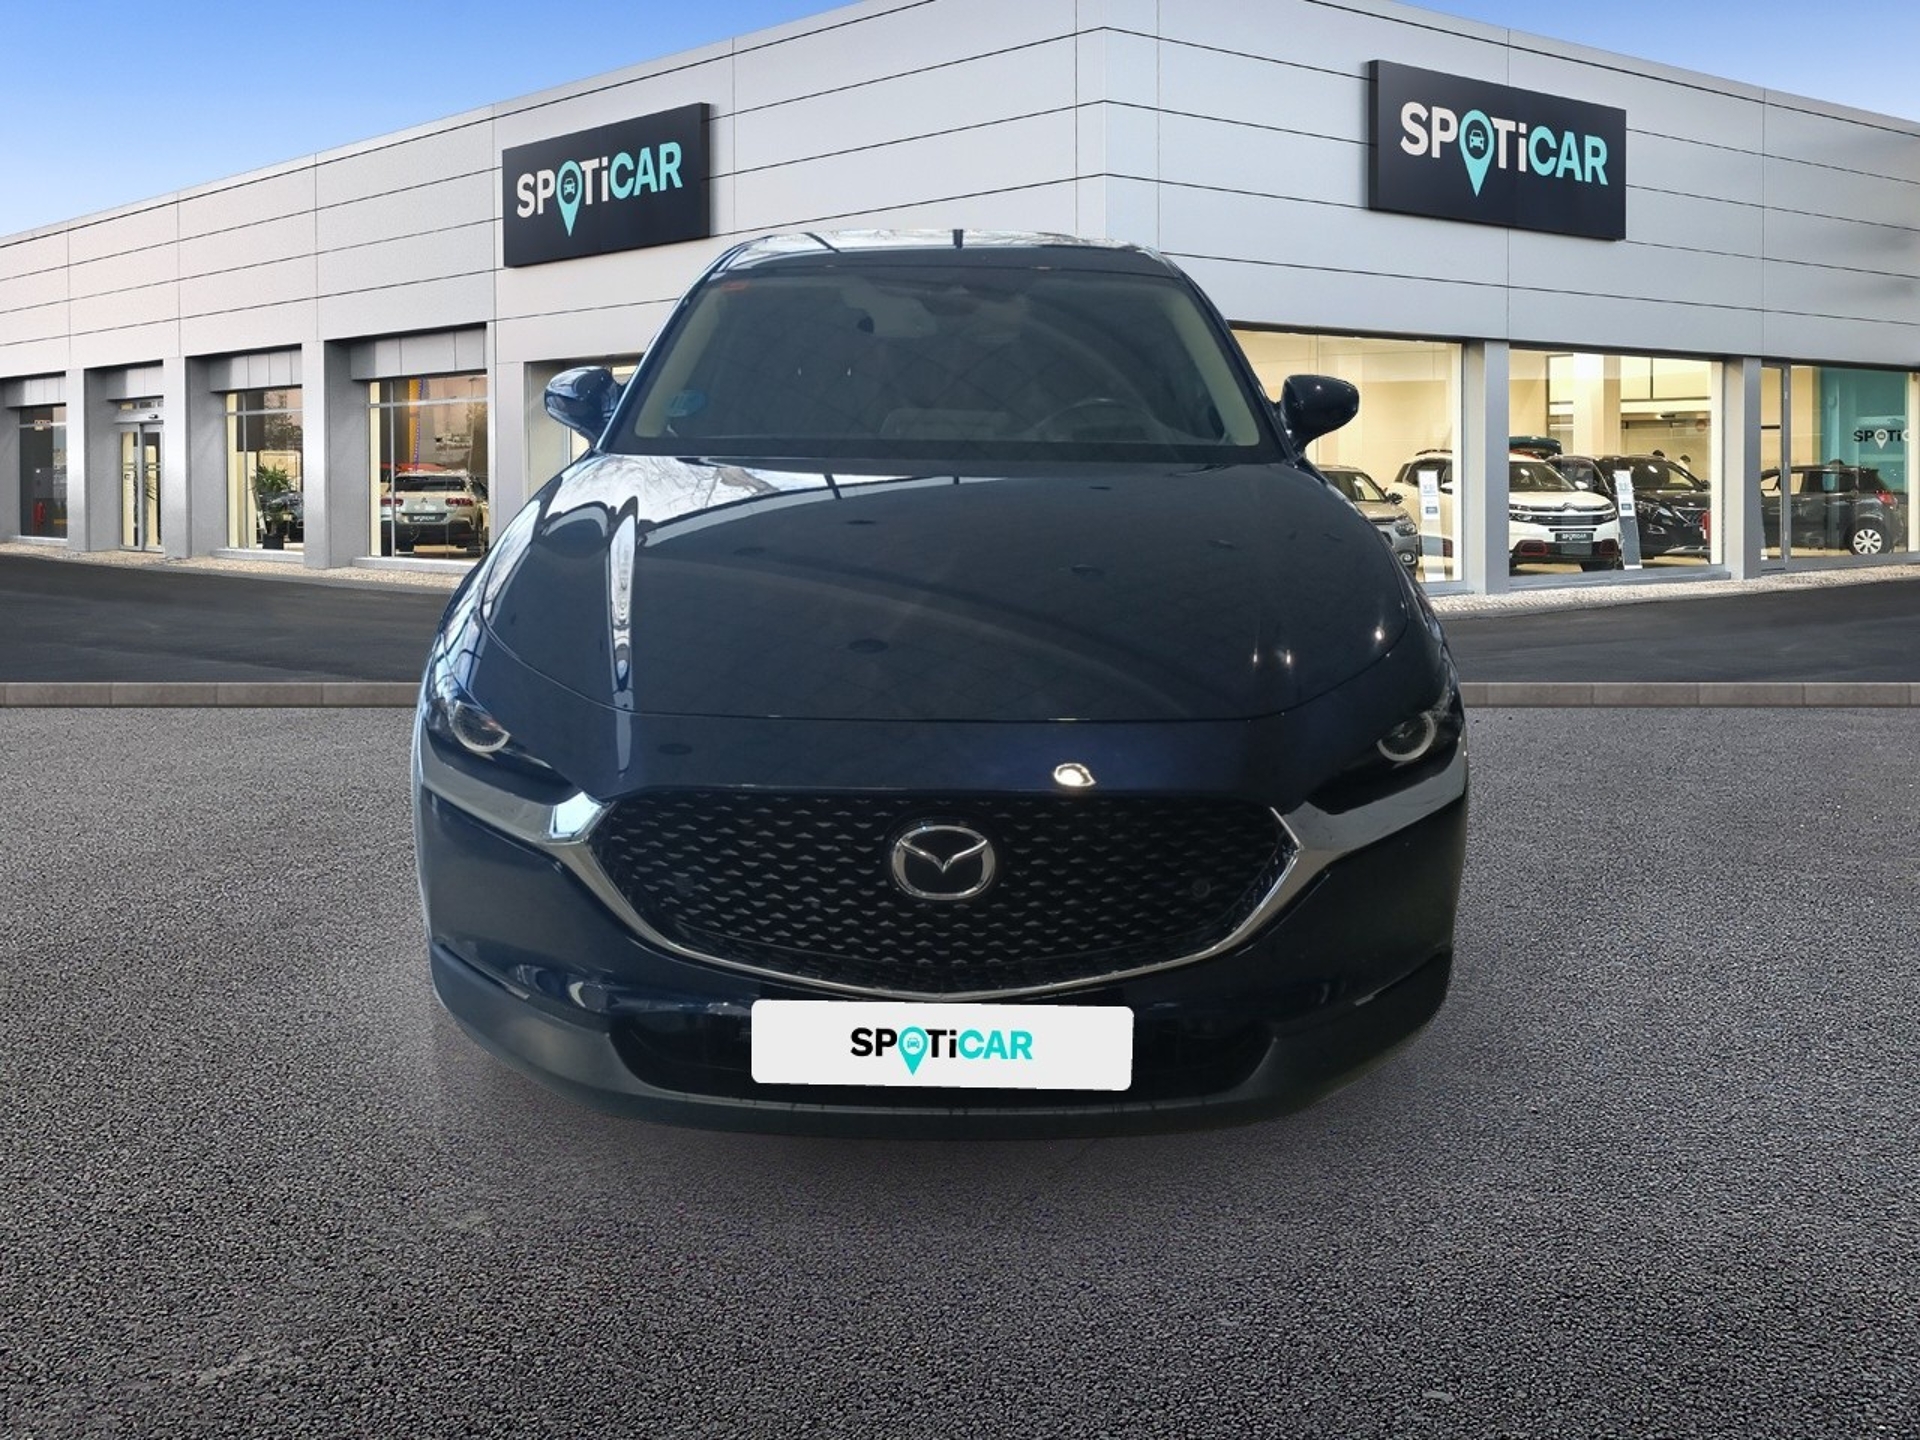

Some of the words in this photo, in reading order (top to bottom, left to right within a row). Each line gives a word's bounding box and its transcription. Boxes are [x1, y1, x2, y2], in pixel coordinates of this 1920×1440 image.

[516, 141, 683, 237] SPOTiCAR
[1400, 101, 1608, 197] SPOTiCAR
[850, 1026, 1033, 1075] SPOTiCAR
